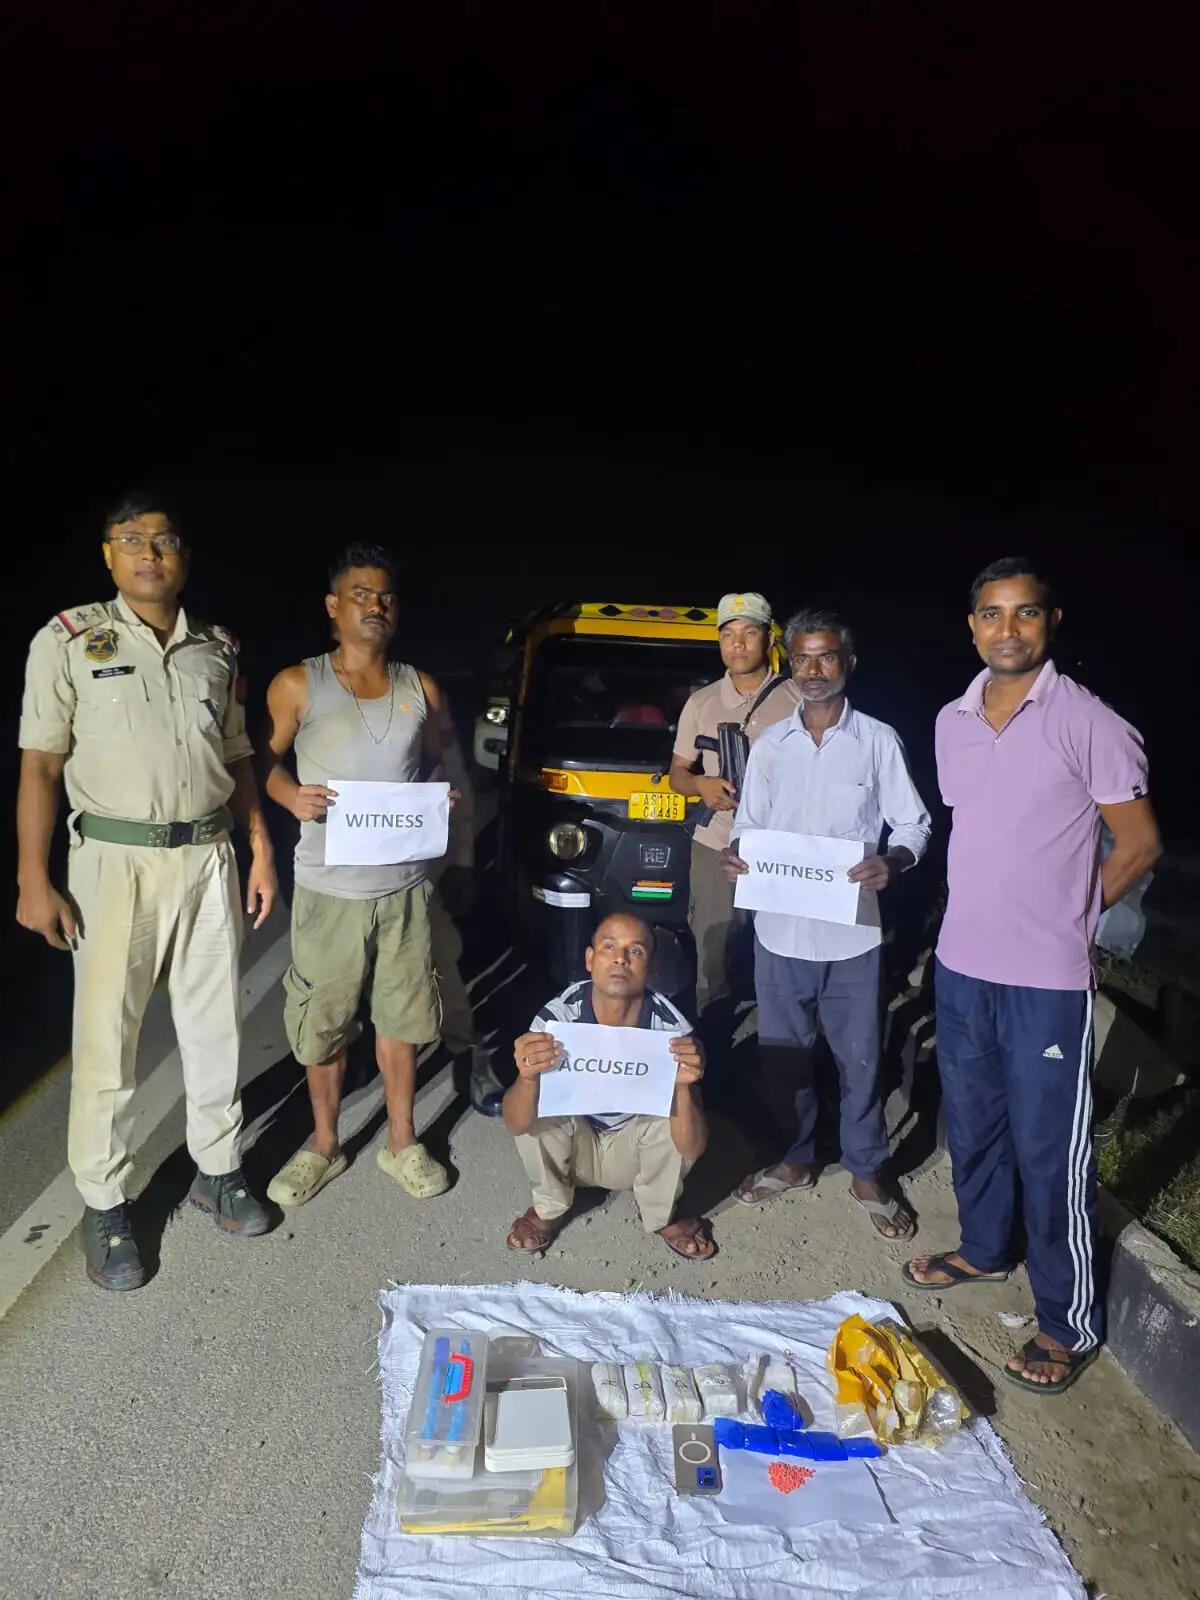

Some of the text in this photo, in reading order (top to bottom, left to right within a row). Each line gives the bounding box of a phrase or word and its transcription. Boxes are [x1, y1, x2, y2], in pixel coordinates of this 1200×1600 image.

[345, 813, 424, 828] WITNESS
[756, 860, 834, 883] WITNESS
[558, 1057, 649, 1077] ACCUSED
